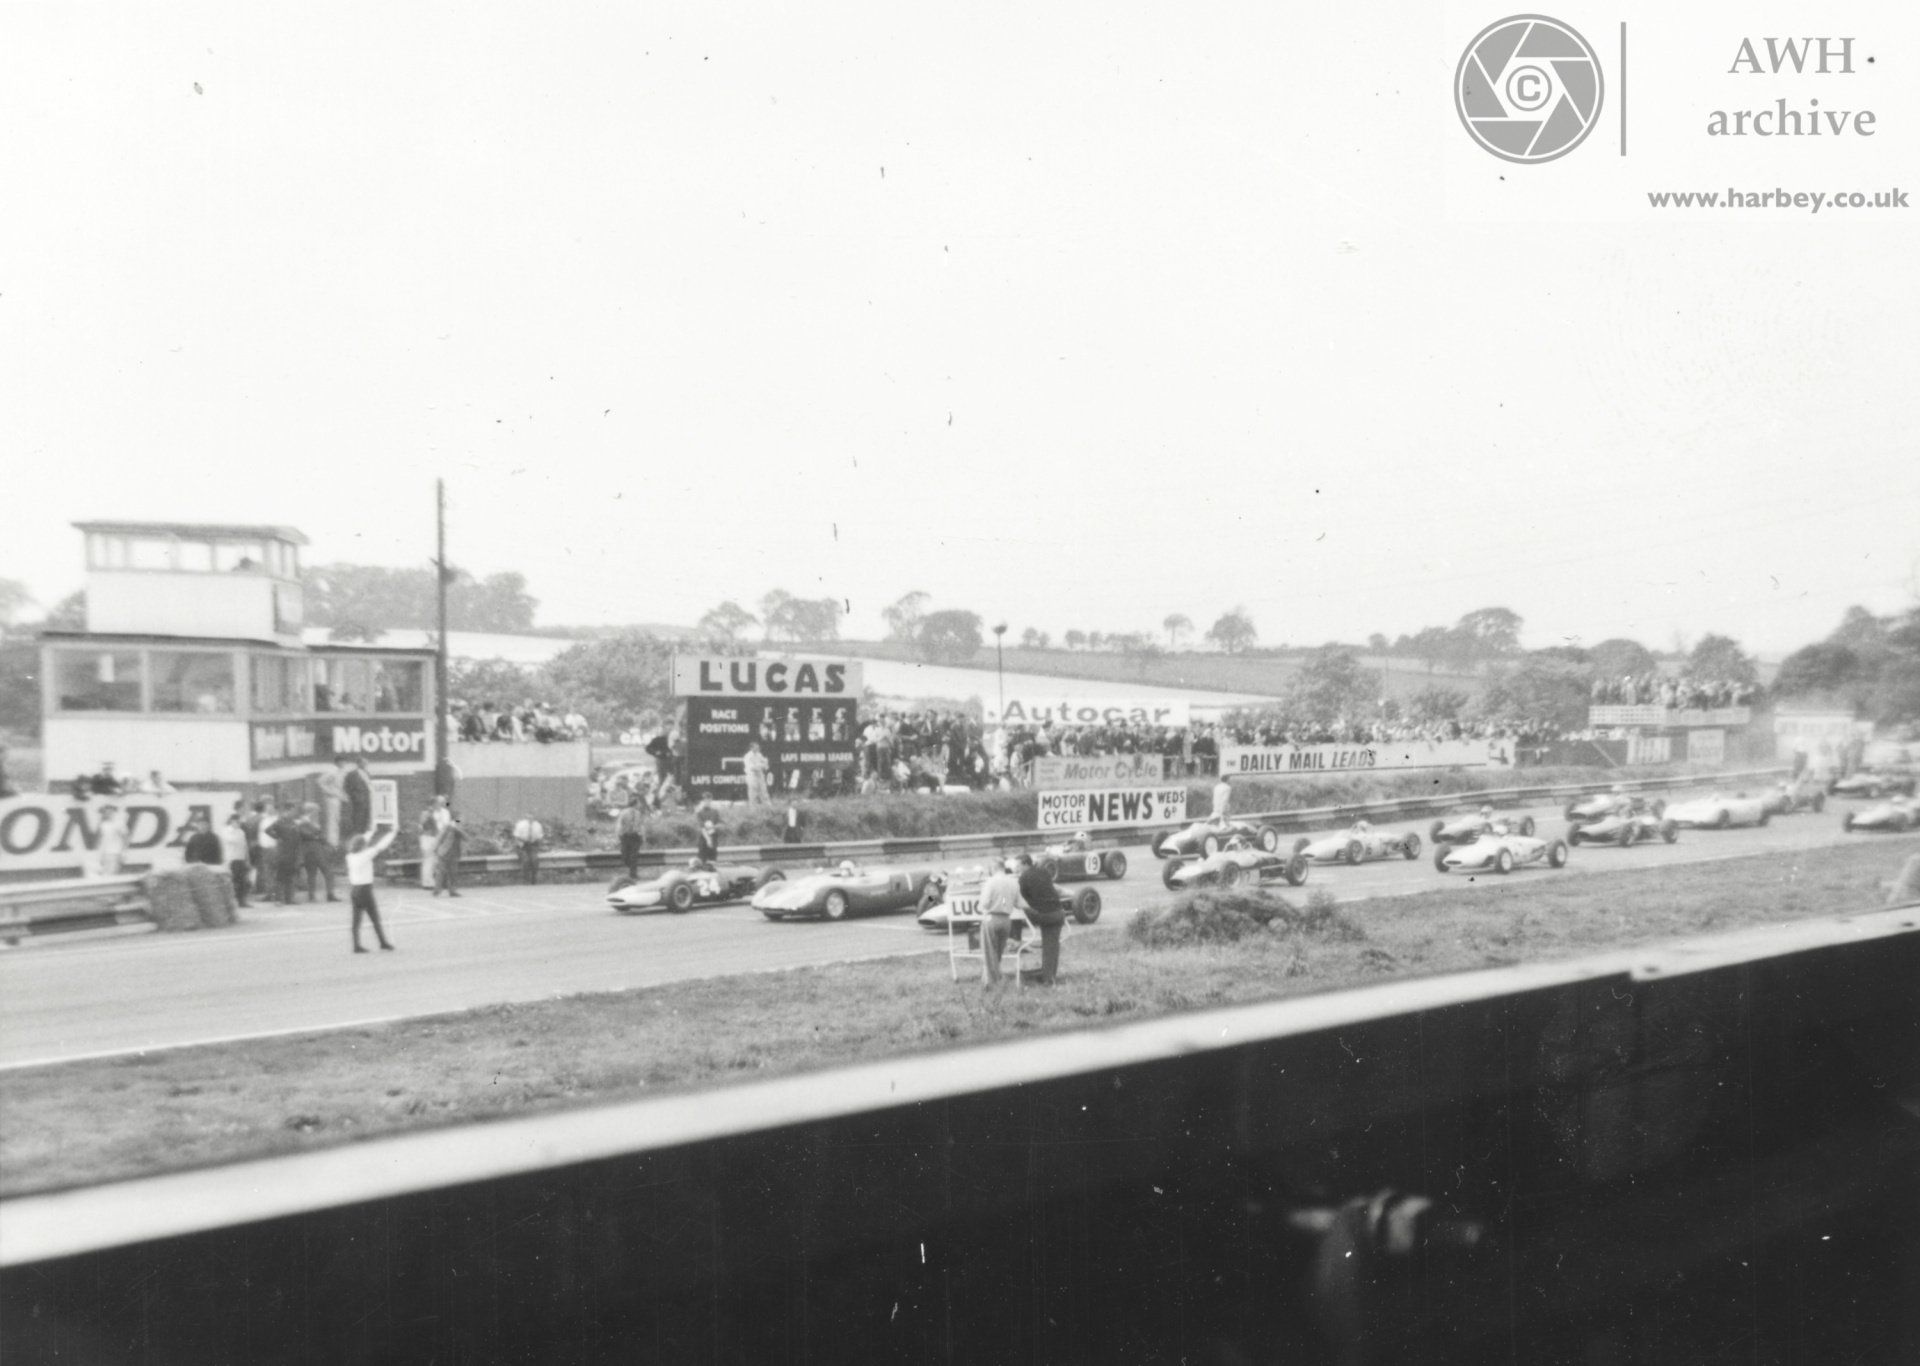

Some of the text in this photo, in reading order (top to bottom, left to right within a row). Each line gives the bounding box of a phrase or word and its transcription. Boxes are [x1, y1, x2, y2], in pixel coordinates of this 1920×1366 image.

[700, 661, 846, 693] LUCAS
[711, 709, 738, 720] RACE
[1002, 700, 1171, 723] Autocar
[699, 722, 750, 733] POSITIONS
[333, 726, 425, 753] Motor
[1240, 754, 1282, 771] DAILY
[1289, 752, 1325, 769] MAIL
[1331, 751, 1376, 768] LEADS
[1063, 763, 1110, 780] Motor
[1114, 761, 1158, 783] Cycle
[1042, 793, 1086, 809] MOTOR
[1157, 791, 1185, 803] WEDS
[1088, 791, 1153, 822] NEWS
[1044, 810, 1082, 825] CYCLE
[0, 804, 212, 855] ONDA
[1087, 856, 1098, 871] 19
[697, 878, 721, 896] 24
[952, 900, 983, 915] LUC
